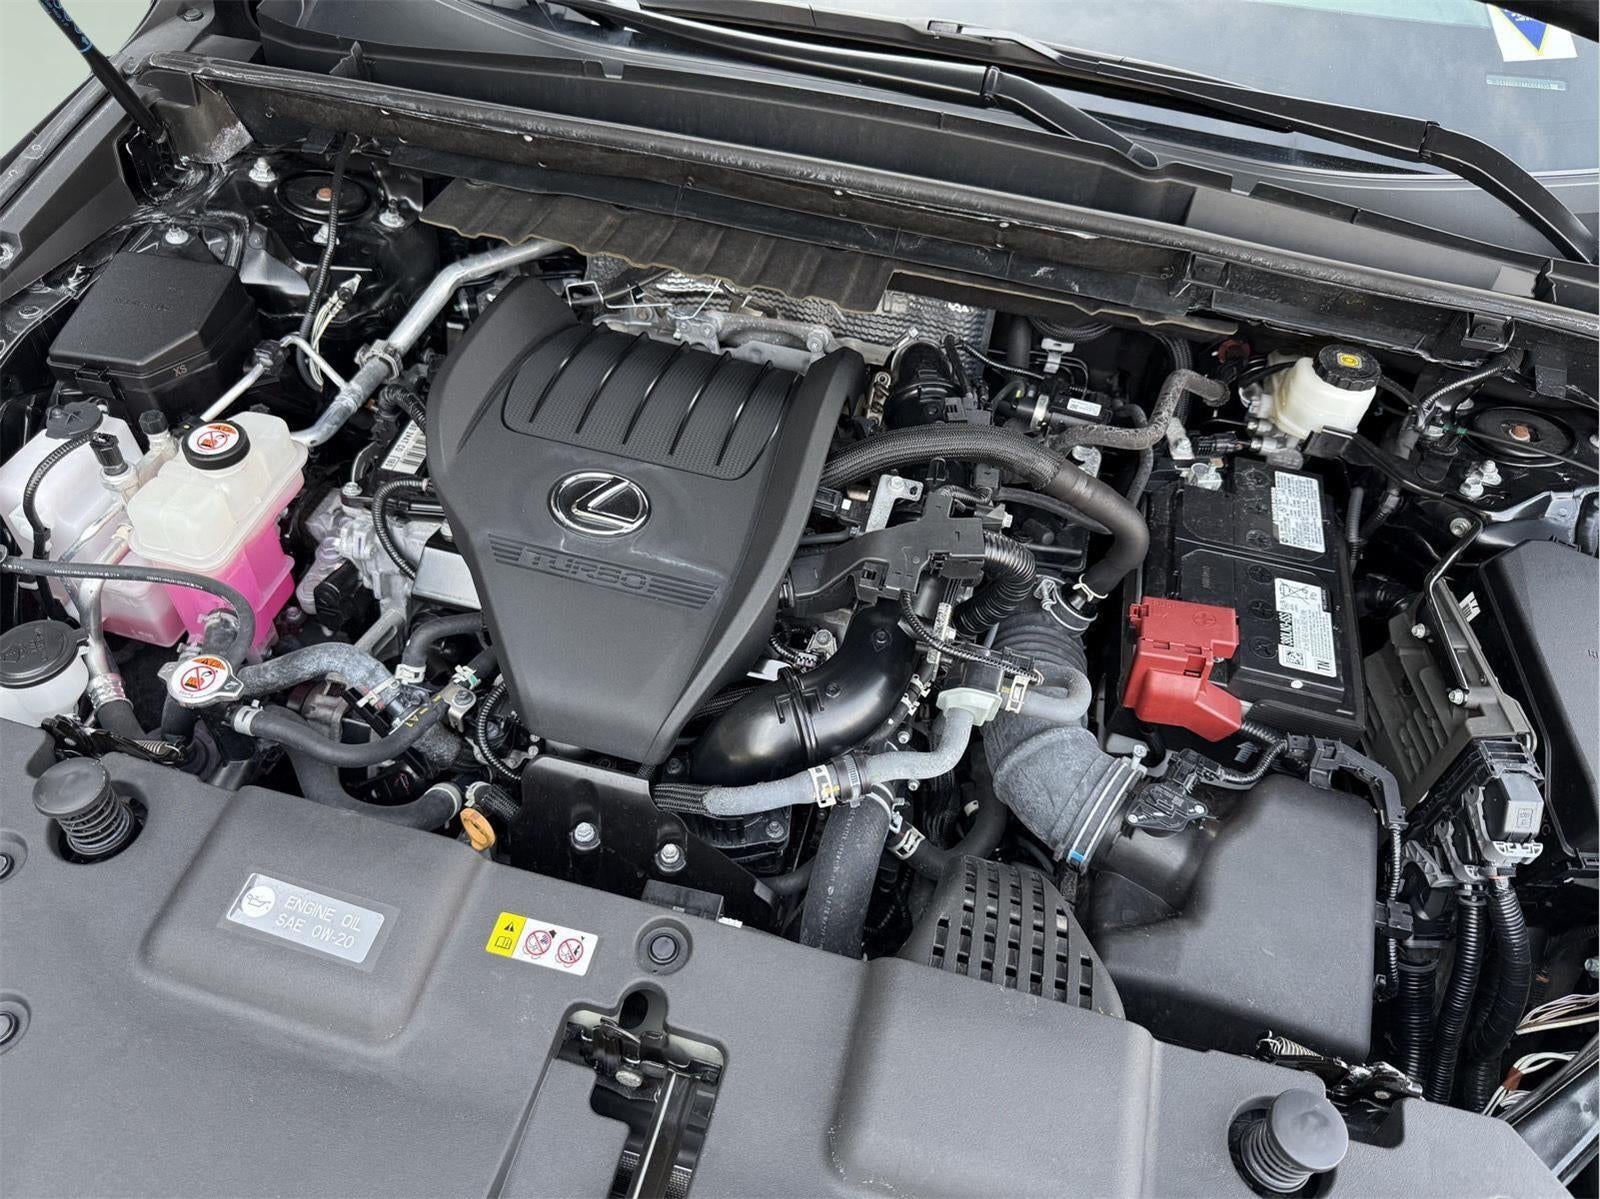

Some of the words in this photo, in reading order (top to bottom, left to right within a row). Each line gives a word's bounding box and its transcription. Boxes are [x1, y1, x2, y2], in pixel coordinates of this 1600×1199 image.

[173, 364, 188, 377] XS
[523, 548, 648, 590] TURBO
[275, 913, 306, 933] SAE
[311, 926, 355, 949] 0W-20
[284, 895, 336, 922] ENGINE
[341, 914, 361, 932] OIL
